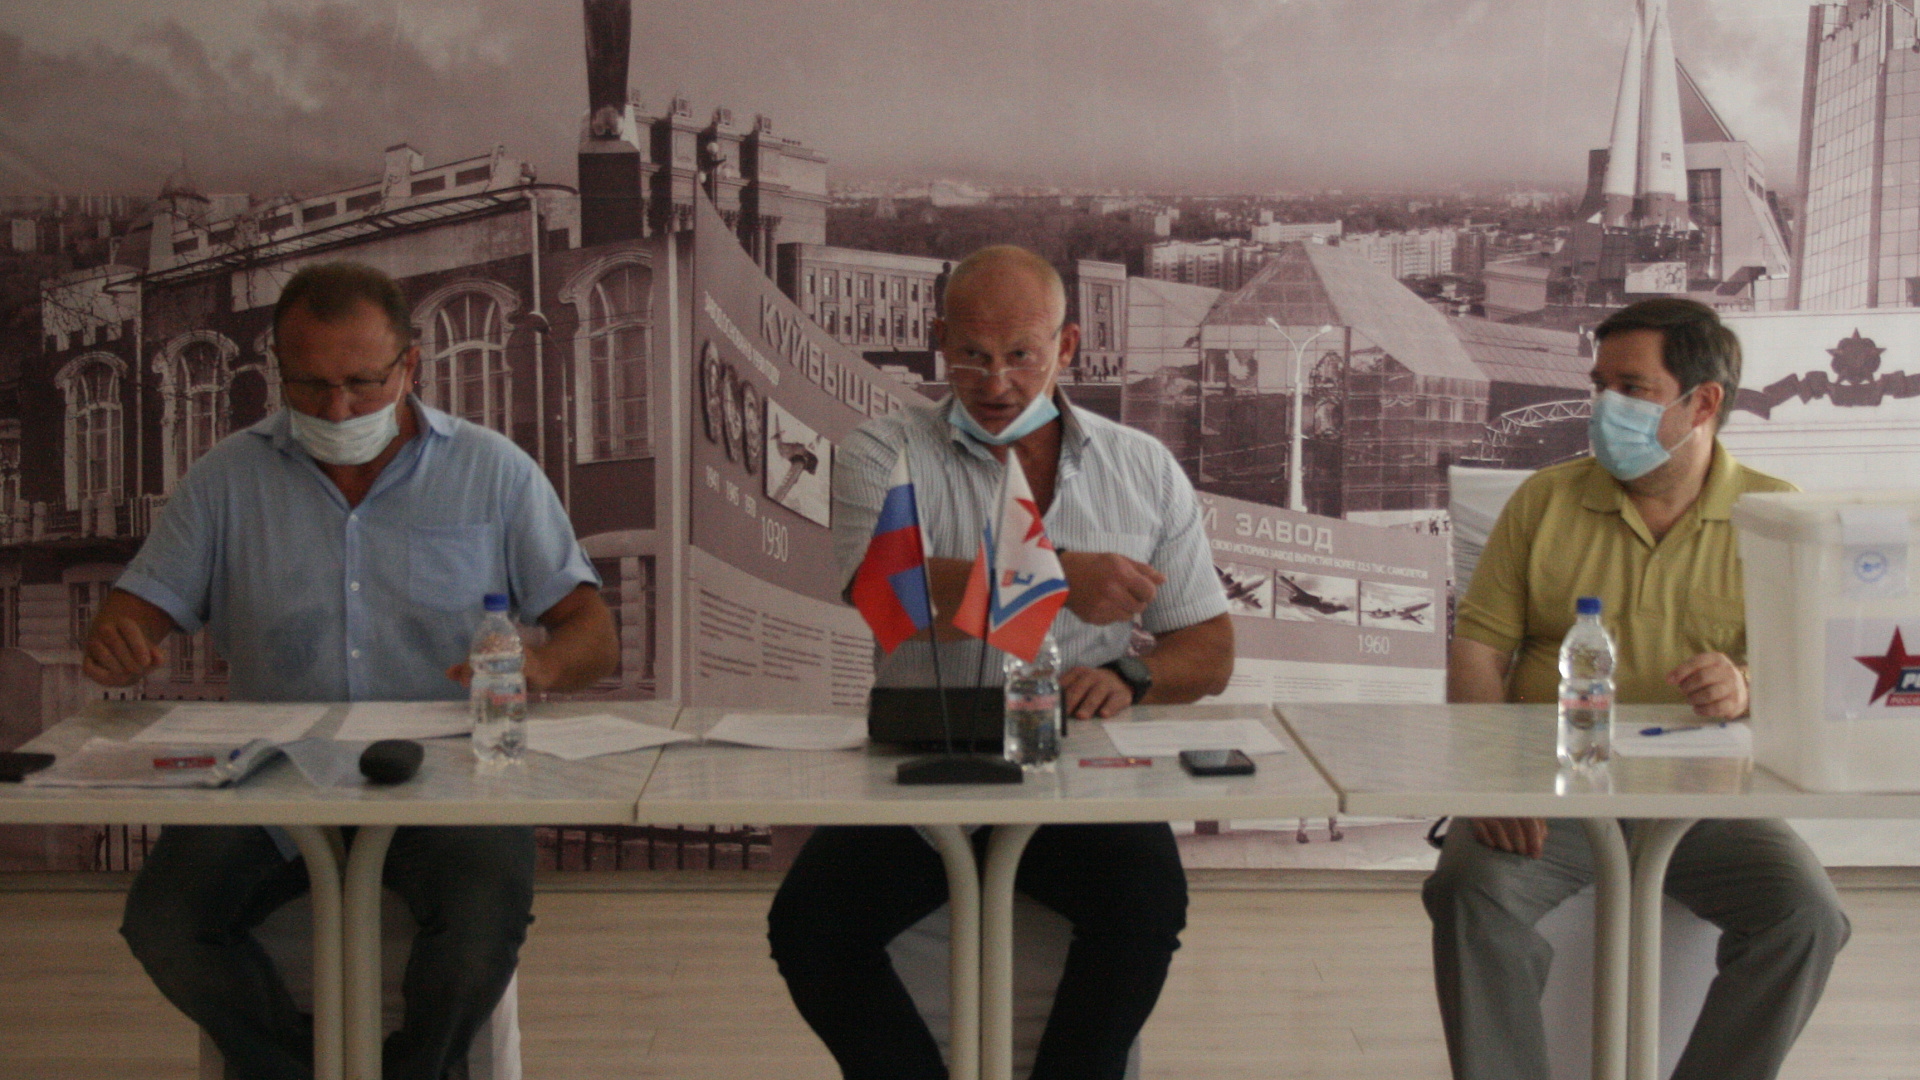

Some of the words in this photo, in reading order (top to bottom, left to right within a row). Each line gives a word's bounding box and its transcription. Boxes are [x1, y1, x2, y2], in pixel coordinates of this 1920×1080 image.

[762, 516, 788, 563] 1930
[1235, 512, 1333, 554] ЗАВОД
[1358, 634, 1390, 655] 1960
